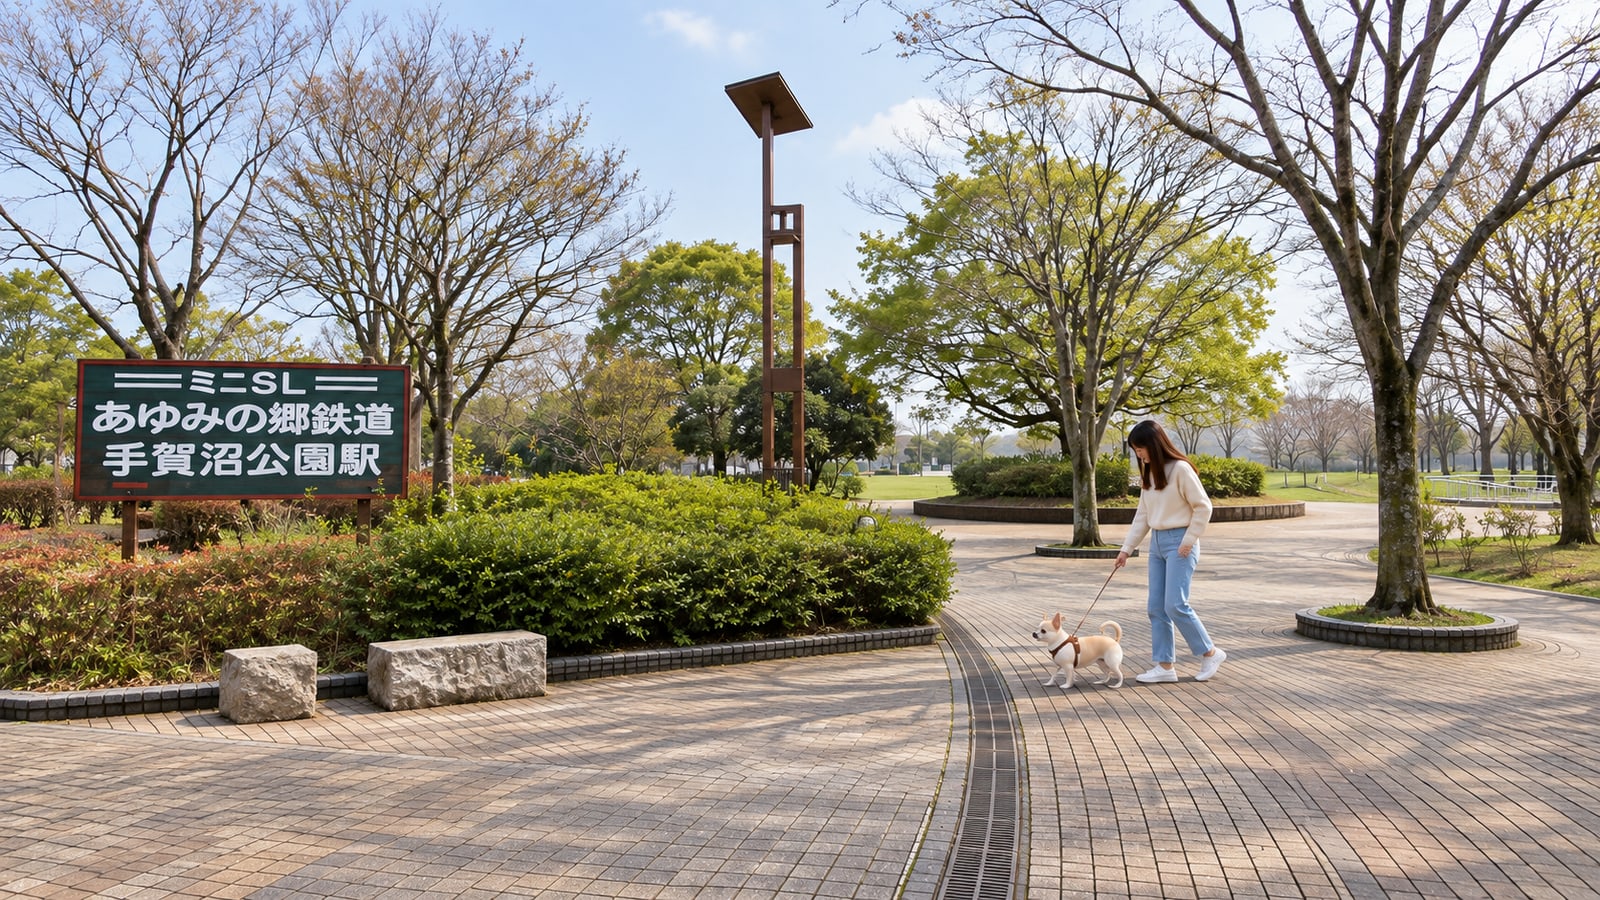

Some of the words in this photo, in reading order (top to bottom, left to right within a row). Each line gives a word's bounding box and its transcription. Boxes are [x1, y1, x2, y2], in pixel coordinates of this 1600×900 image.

[190, 370, 306, 395] ミニSL
[93, 401, 394, 435] あゆみの郷鉄道
[103, 442, 381, 476] 手賀沼公園駅
